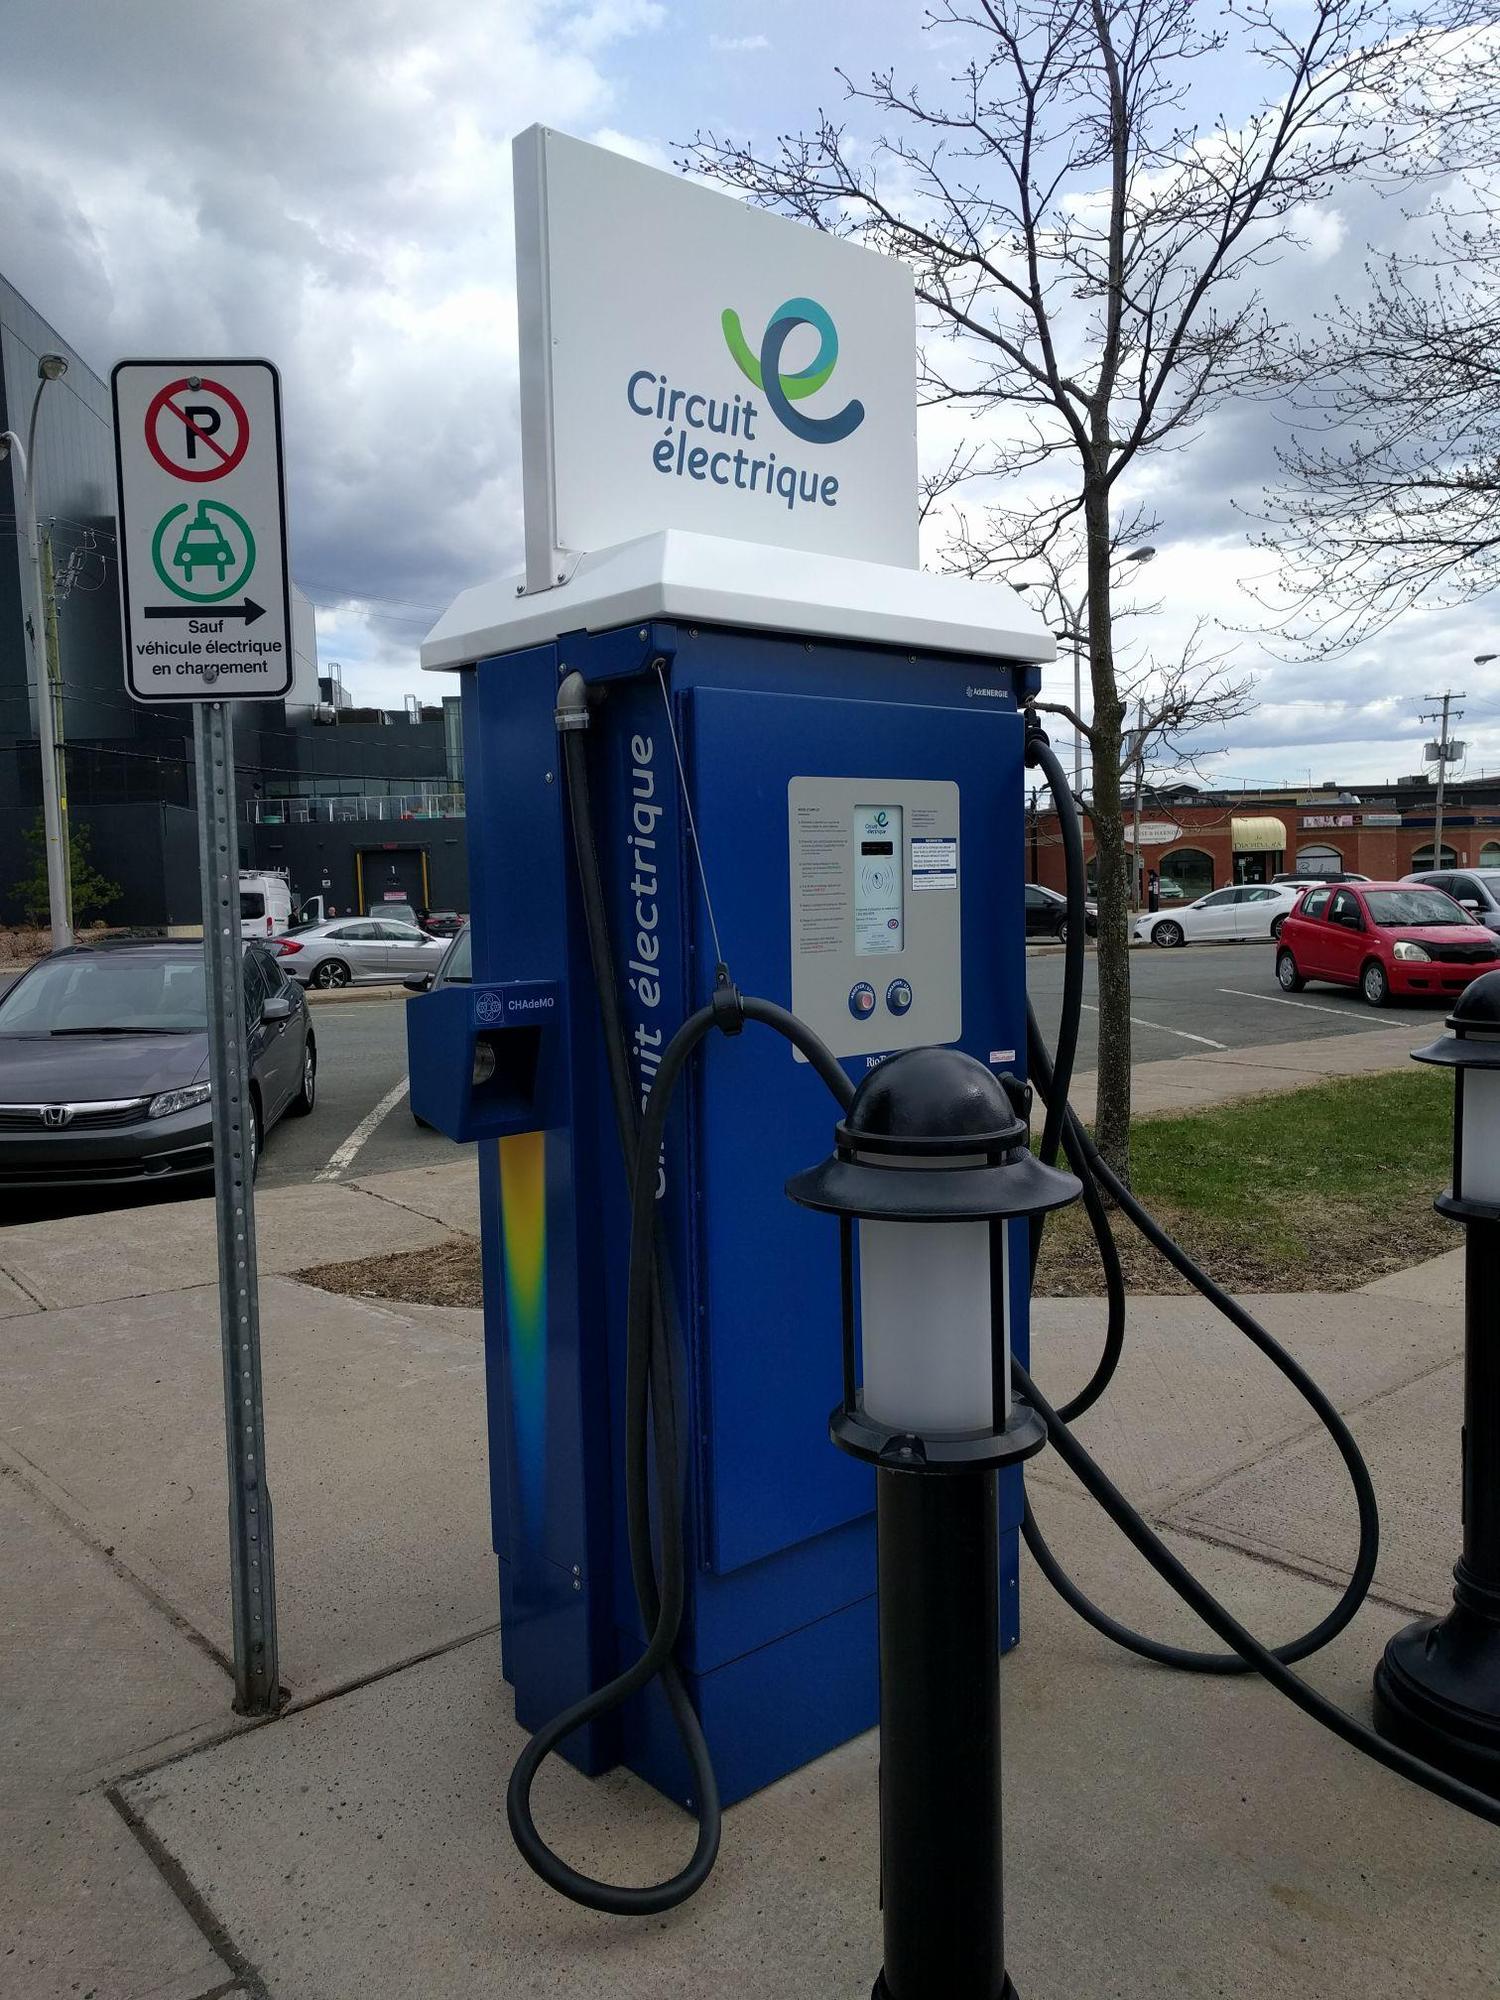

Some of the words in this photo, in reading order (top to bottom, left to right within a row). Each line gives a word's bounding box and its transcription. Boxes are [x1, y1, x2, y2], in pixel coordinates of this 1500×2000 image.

[627, 370, 758, 440] Circuit
[185, 406, 221, 459] P
[652, 426, 839, 510] électrique
[188, 619, 224, 635] Sauf
[136, 640, 202, 656] véhicule
[205, 639, 282, 657] électrique
[152, 665, 172, 676] en
[176, 658, 268, 676] chargement
[627, 734, 663, 1007] électrique
[508, 998, 554, 1010] CHAdeMO
